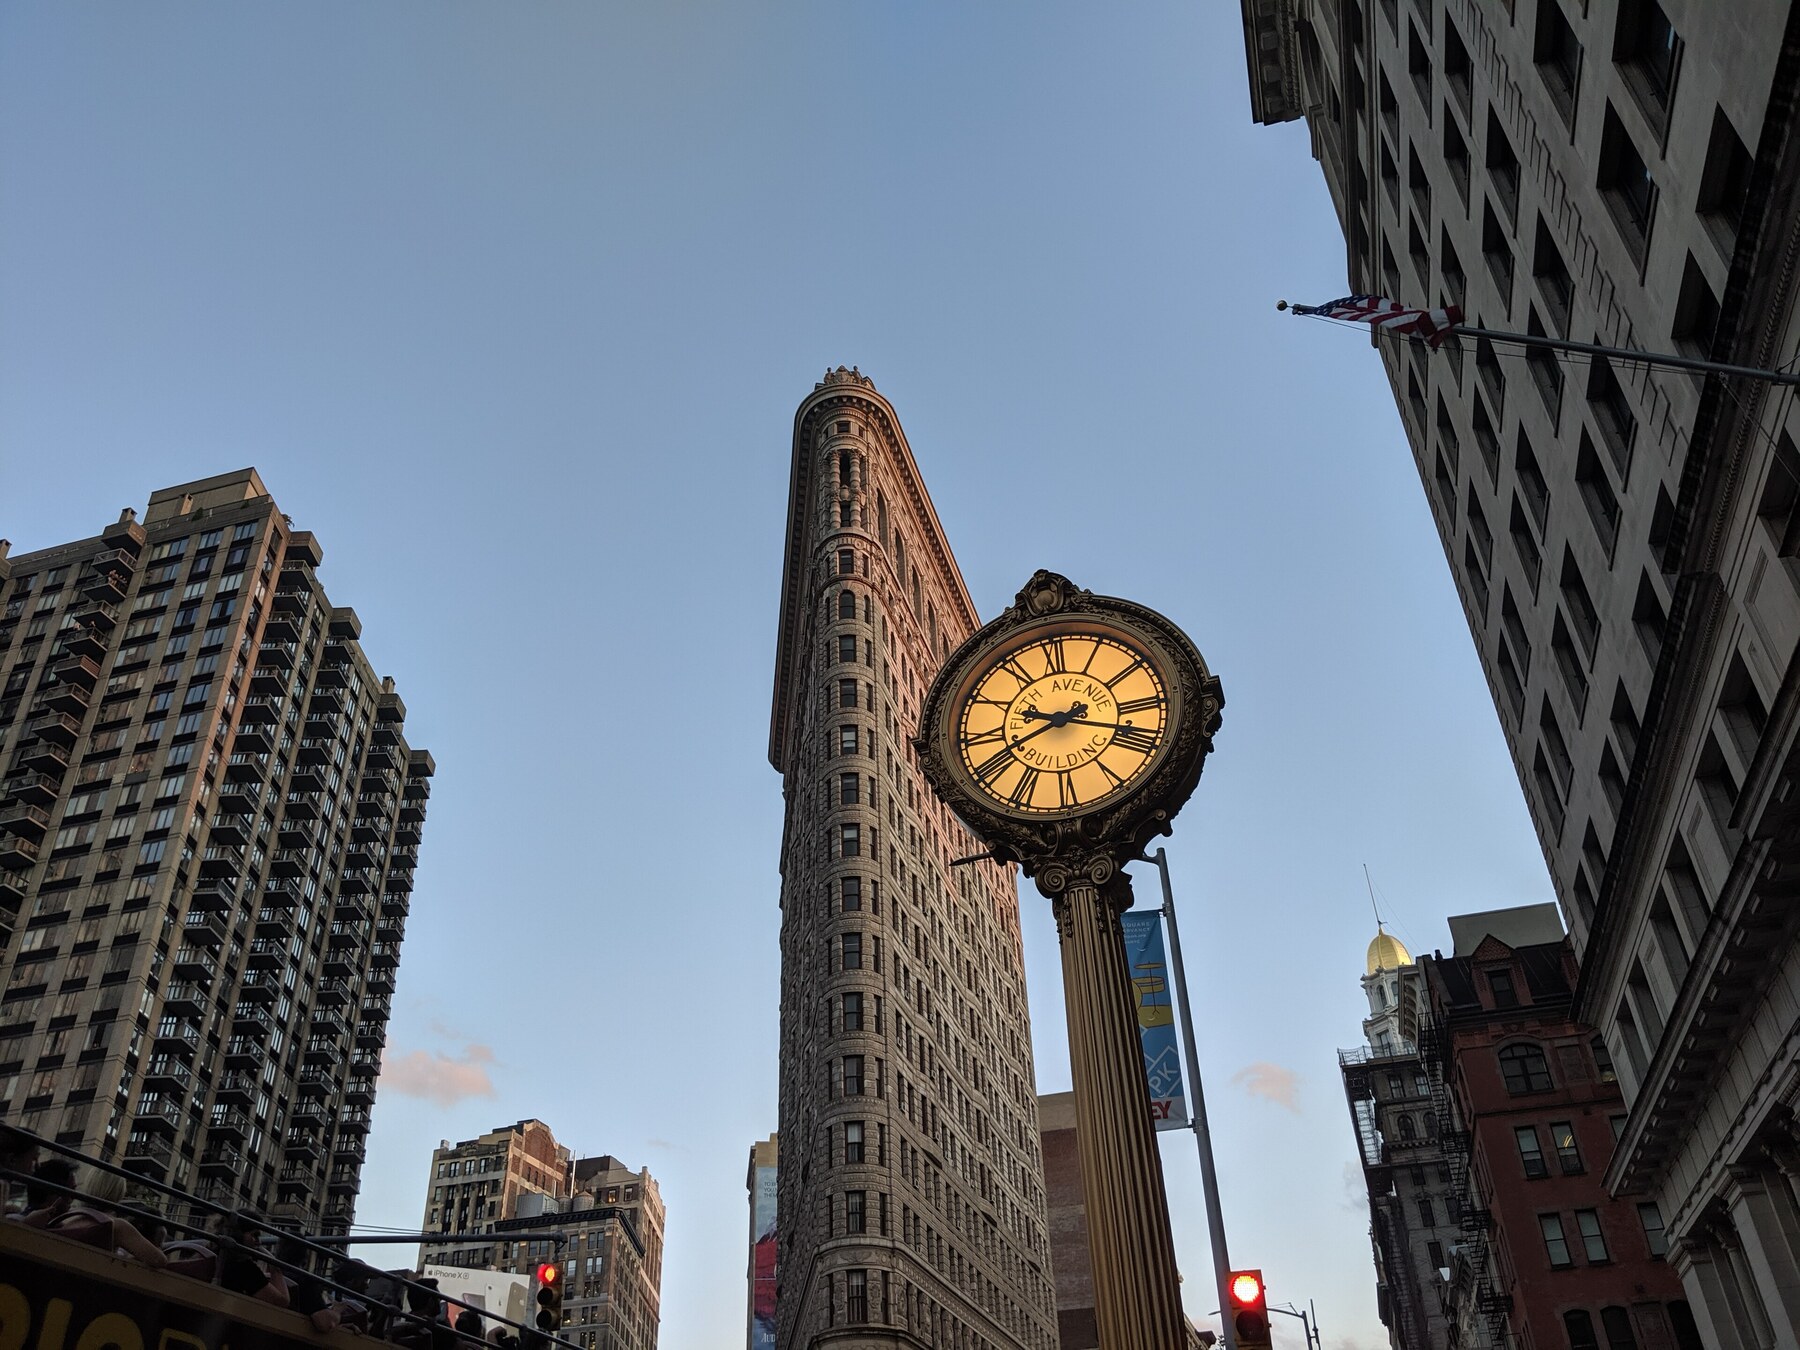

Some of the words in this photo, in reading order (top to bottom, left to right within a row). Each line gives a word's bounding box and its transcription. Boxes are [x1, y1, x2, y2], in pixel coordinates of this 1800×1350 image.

[1010, 688, 1043, 730] FIFTH
[1052, 678, 1111, 712] AVENUE
[1023, 734, 1107, 769] BUILDING
[434, 1270, 456, 1279] iPhone
